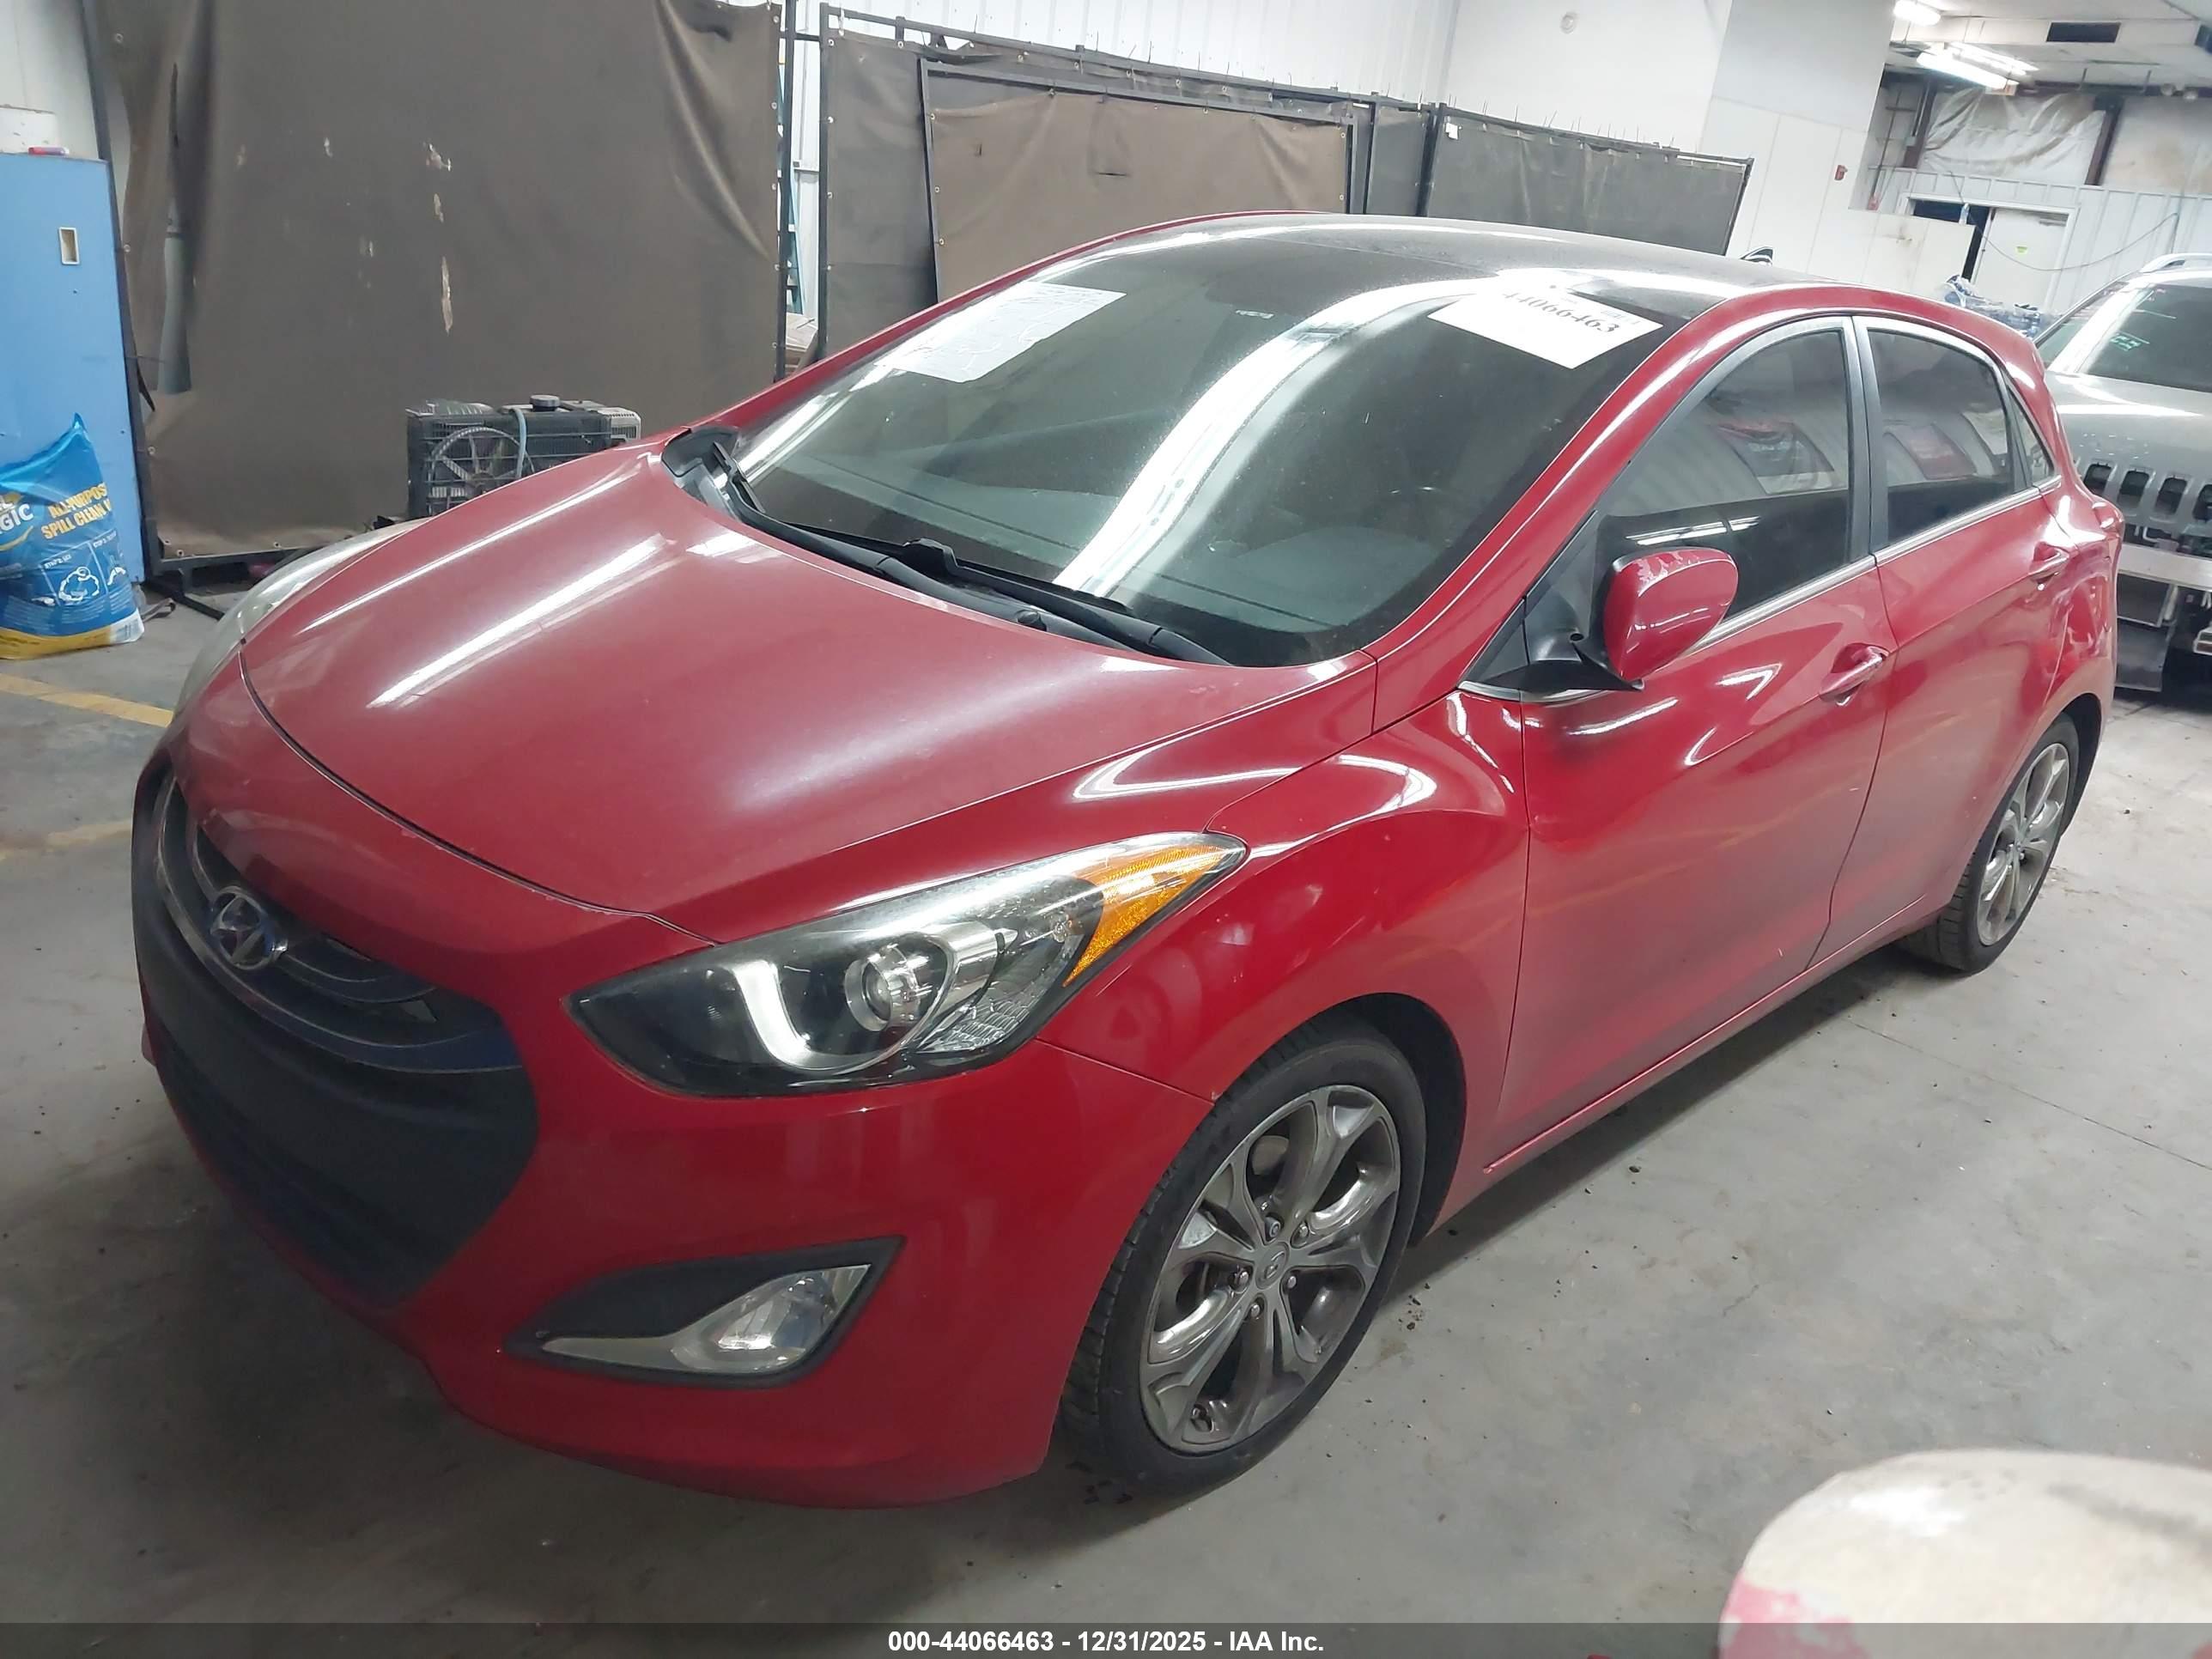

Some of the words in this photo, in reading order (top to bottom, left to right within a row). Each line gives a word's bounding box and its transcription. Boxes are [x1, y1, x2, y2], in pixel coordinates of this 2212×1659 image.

[1502, 292, 1620, 333] 44066463
[0, 503, 34, 532] GIC
[40, 517, 76, 539] SPILL
[73, 502, 107, 526] CLEAN
